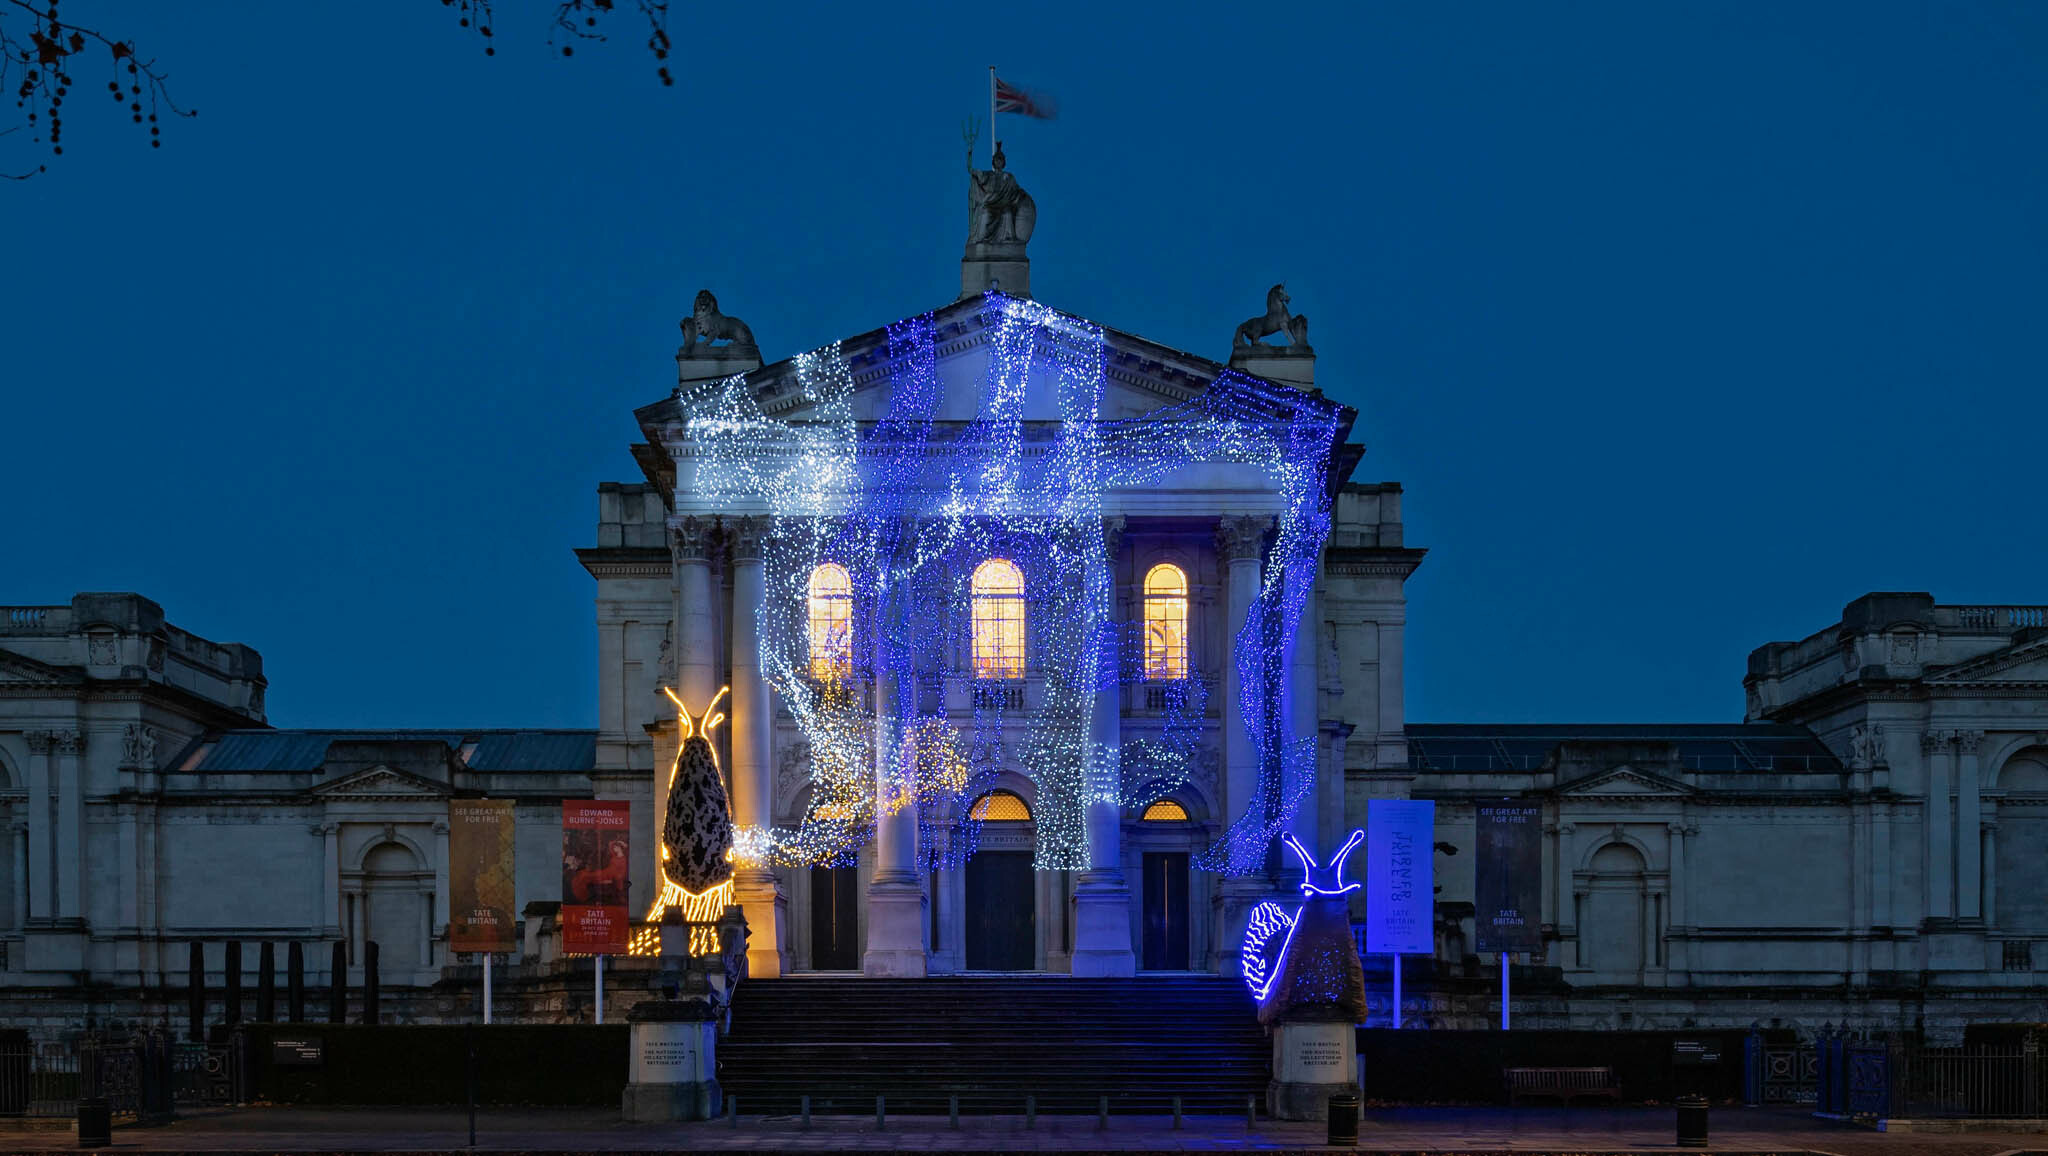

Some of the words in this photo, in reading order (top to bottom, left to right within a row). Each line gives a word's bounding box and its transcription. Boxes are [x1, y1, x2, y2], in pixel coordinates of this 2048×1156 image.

[579, 809, 613, 817] EDWARD
[1480, 808, 1495, 816] SEE
[1496, 808, 1521, 816] GREAT
[1522, 808, 1537, 816] ART
[465, 815, 480, 823] FOR
[482, 815, 500, 823] FREE
[569, 817, 624, 825] BURNE-JONES
[1492, 816, 1507, 824] FOR
[1509, 816, 1528, 824] FREE
[473, 909, 491, 917] TATE
[586, 910, 604, 918] TATE
[1499, 909, 1518, 918] TATE
[467, 917, 498, 925] BRITAIN
[580, 918, 611, 926] BRITAIN
[1385, 917, 1416, 925] BRITAIN
[1493, 917, 1524, 926] BRITAIN
